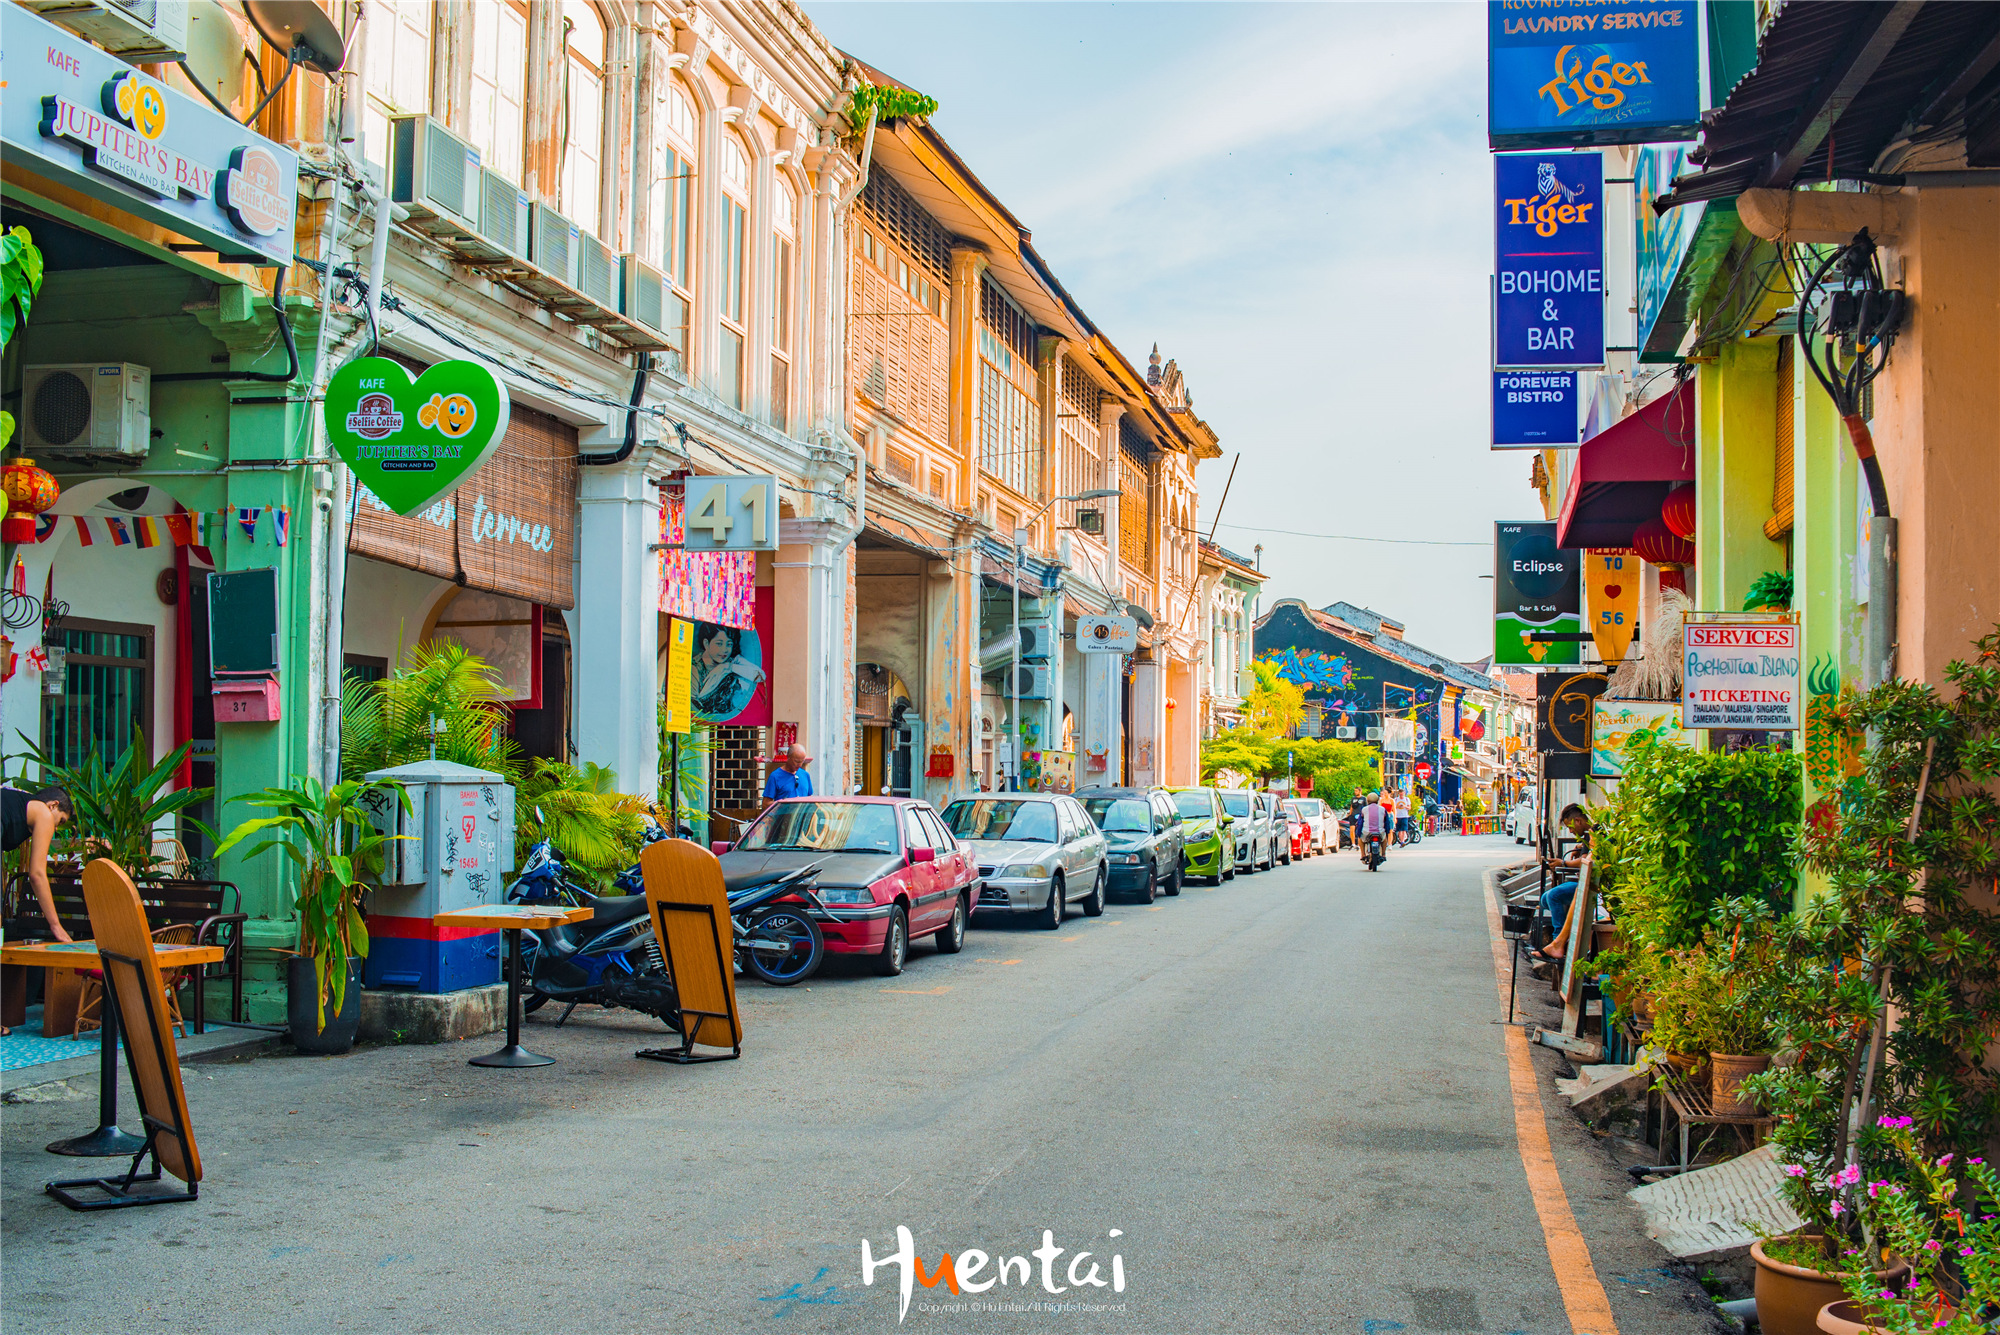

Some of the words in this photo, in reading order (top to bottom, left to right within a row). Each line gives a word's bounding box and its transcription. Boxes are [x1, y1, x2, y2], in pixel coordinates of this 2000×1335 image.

[1504, 14, 1599, 34] LAUNDRY
[1602, 10, 1683, 30] SERVICE
[47, 46, 80, 78] KAFE
[1538, 50, 1653, 117] Tiger
[99, 151, 138, 178] KITCHEN
[139, 167, 159, 188] AND
[160, 178, 177, 197] BAR
[175, 158, 214, 195] BAY
[231, 180, 260, 208] #Selfie
[261, 193, 289, 221] Coffee
[1504, 195, 1594, 237] Tiger
[1501, 269, 1600, 294] BOHOME
[1542, 298, 1559, 321] &
[1527, 327, 1574, 350] BAR
[359, 379, 385, 389] KAFE
[1500, 376, 1571, 388] FOREVER
[1507, 391, 1564, 403] BISTRO
[348, 417, 375, 426] #Selfie
[376, 417, 402, 426] Coffee
[432, 445, 463, 458] BAY
[689, 484, 767, 541] 41
[472, 494, 554, 553] terrace
[1513, 560, 1563, 575] Eclipse
[1604, 557, 1623, 570] TO
[1519, 604, 1532, 612] Bar
[1602, 611, 1624, 625] 56
[1694, 629, 1789, 645] SERVICES
[1759, 654, 1799, 677] ISLAND
[1700, 690, 1791, 703] TICKETING
[233, 702, 247, 713] 37
[1693, 704, 1788, 714] THAILAND/MALAYSIA/SINGAPORE
[1506, 740, 1517, 749] 71
[460, 791, 478, 799] BAHAYA
[459, 857, 478, 868] 15454
